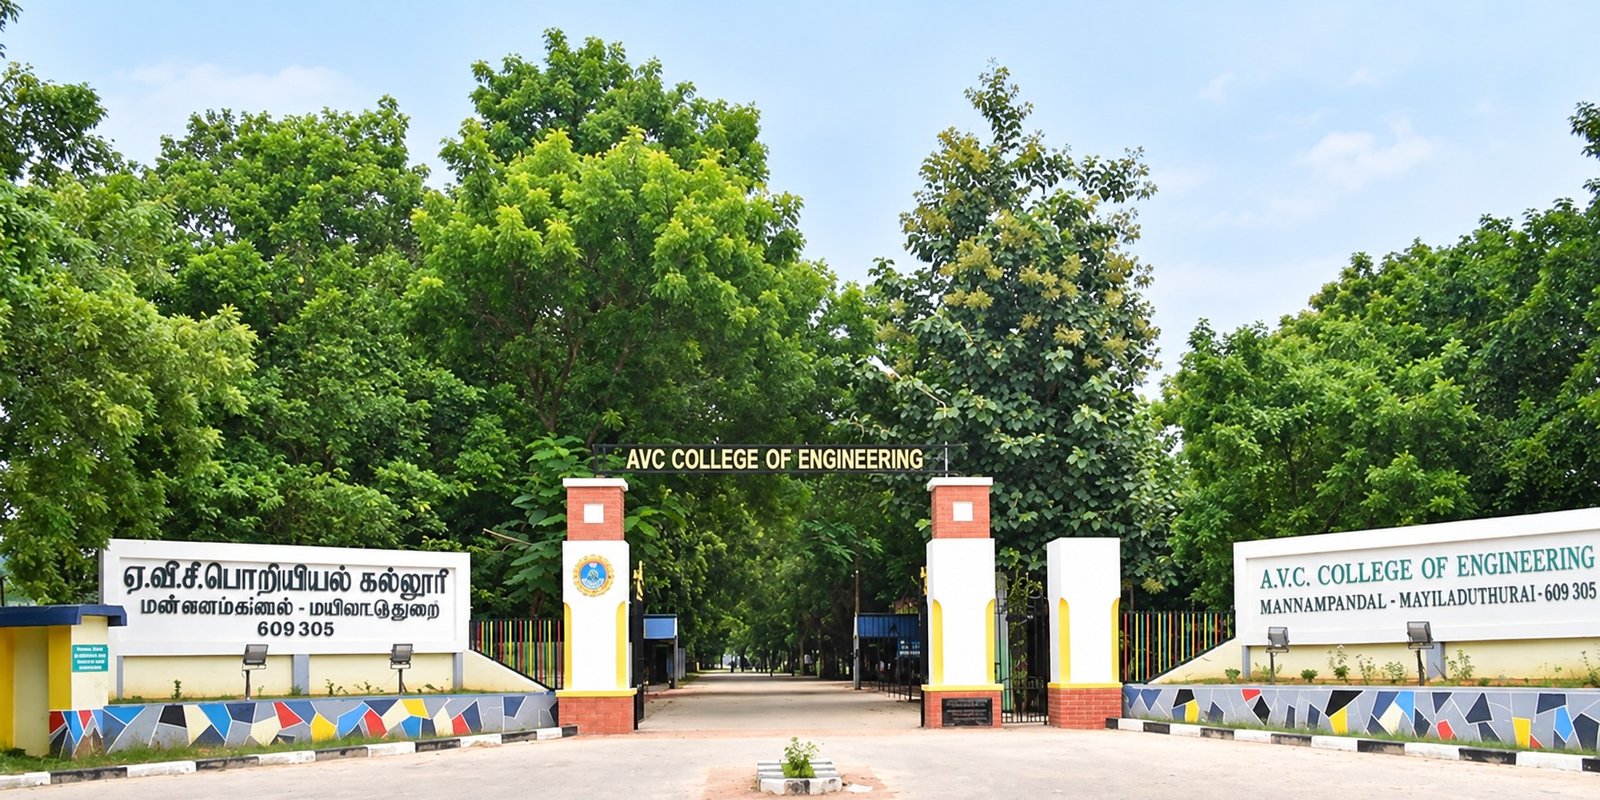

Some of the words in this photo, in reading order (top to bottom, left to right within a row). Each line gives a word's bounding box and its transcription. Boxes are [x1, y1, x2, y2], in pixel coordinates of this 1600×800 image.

[626, 448, 666, 470] AVC
[671, 448, 759, 470] COLLEGE
[765, 448, 792, 470] OF
[798, 448, 924, 470] ENGINEERING
[1260, 566, 1311, 590] A.V.C.
[1317, 558, 1413, 586] COLLEGE
[1421, 556, 1448, 580] OF
[1456, 544, 1596, 578] ENGINEERING
[1260, 593, 1387, 616] MANNAMPANDAL
[1399, 584, 1536, 609] MAYILADUTHURAI
[1544, 582, 1569, 602] 609
[1572, 581, 1597, 601] 305
[257, 620, 295, 637] 609
[298, 621, 335, 637] 305
